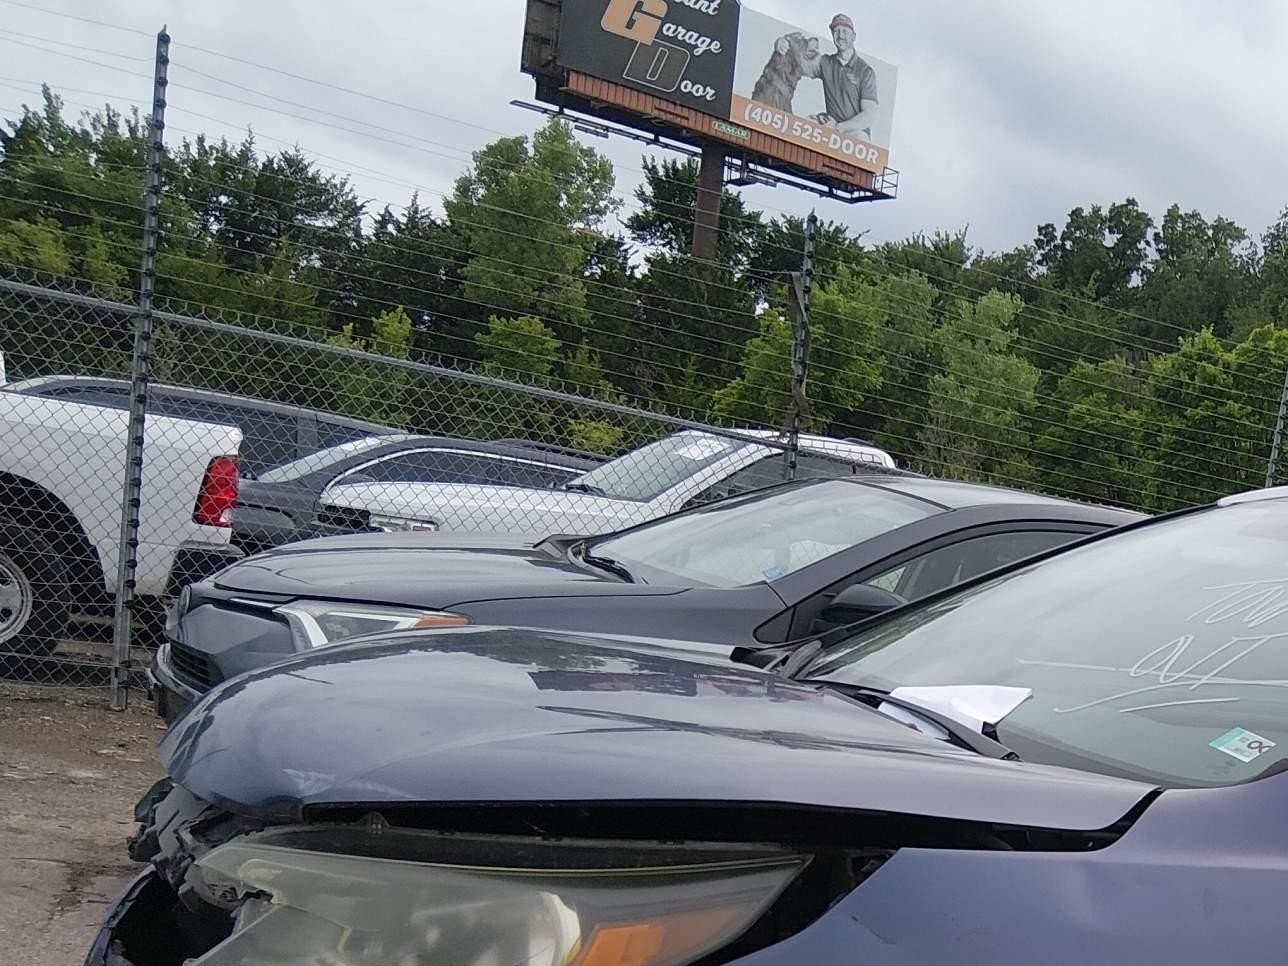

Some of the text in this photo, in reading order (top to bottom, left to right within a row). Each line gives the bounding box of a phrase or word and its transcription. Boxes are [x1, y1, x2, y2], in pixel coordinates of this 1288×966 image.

[674, 0, 720, 15] unt
[744, 103, 880, 164] (405) 525-DOOR
